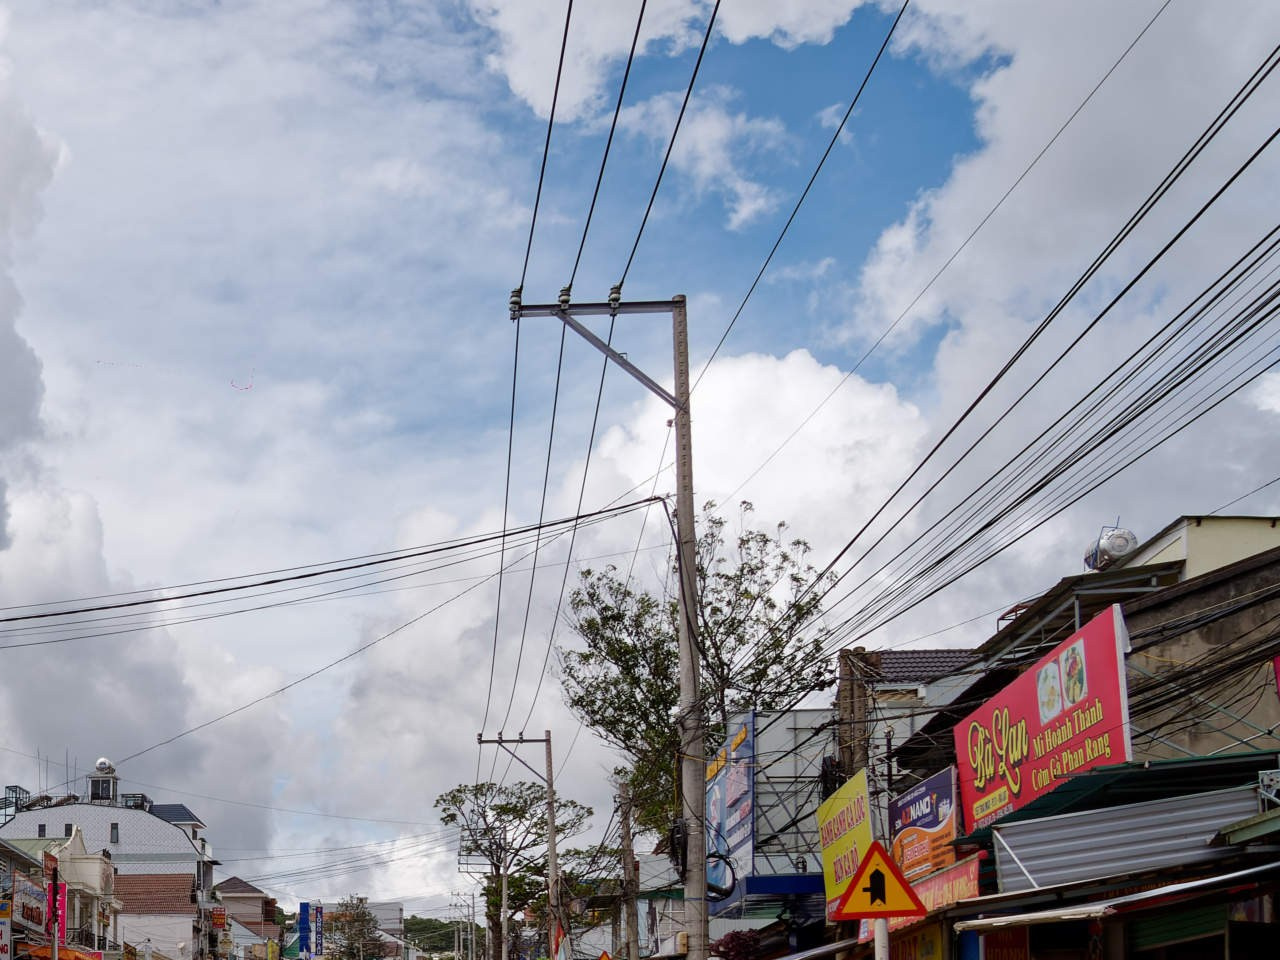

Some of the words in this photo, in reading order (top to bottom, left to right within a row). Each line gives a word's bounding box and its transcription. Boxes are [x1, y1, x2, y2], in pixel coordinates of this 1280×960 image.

[968, 721, 995, 787] Bà
[992, 707, 1029, 793] Lan
[1045, 716, 1073, 752] Hoành
[1073, 698, 1104, 734] Thánh
[1032, 766, 1051, 791] Cơm
[1050, 755, 1062, 781] Gà
[1062, 747, 1084, 775] Phan
[1084, 733, 1111, 762] Rang
